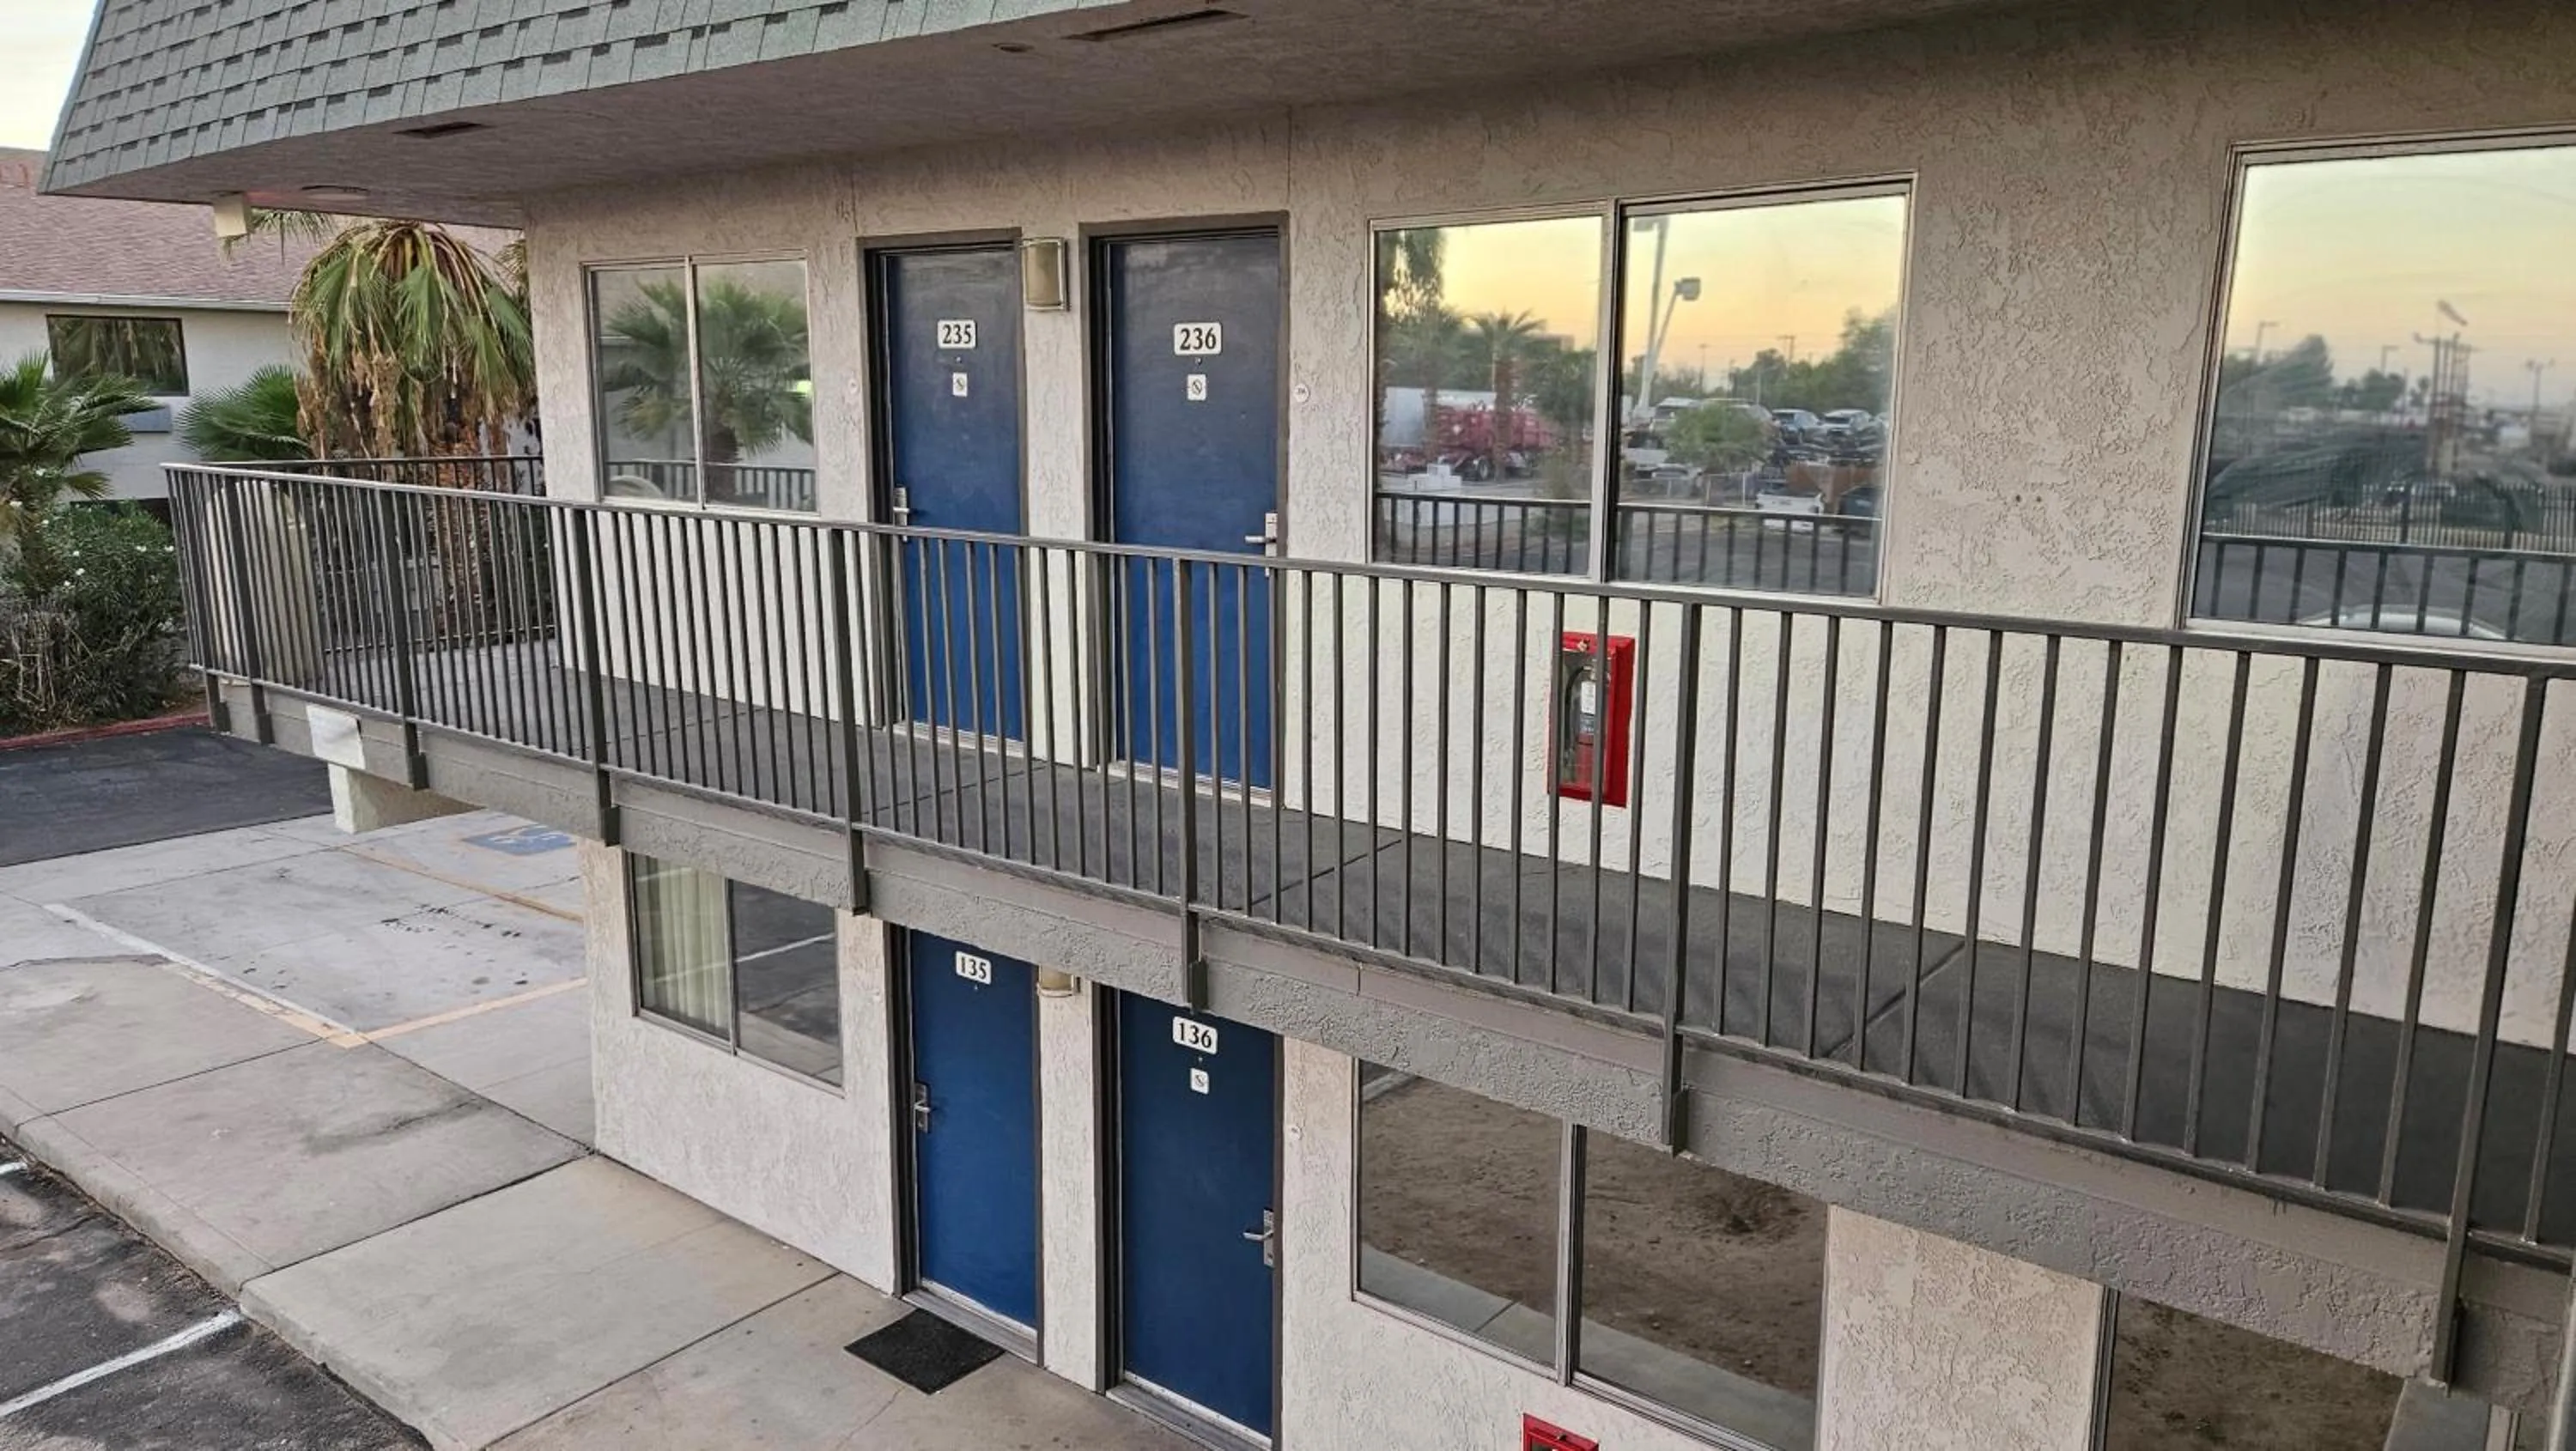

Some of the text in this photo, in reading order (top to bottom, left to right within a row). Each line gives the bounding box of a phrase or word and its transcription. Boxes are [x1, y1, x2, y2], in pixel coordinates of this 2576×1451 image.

[943, 325, 972, 344] 235
[1180, 329, 1217, 350] 236
[960, 955, 987, 980] 135
[1178, 1023, 1212, 1048] 136
